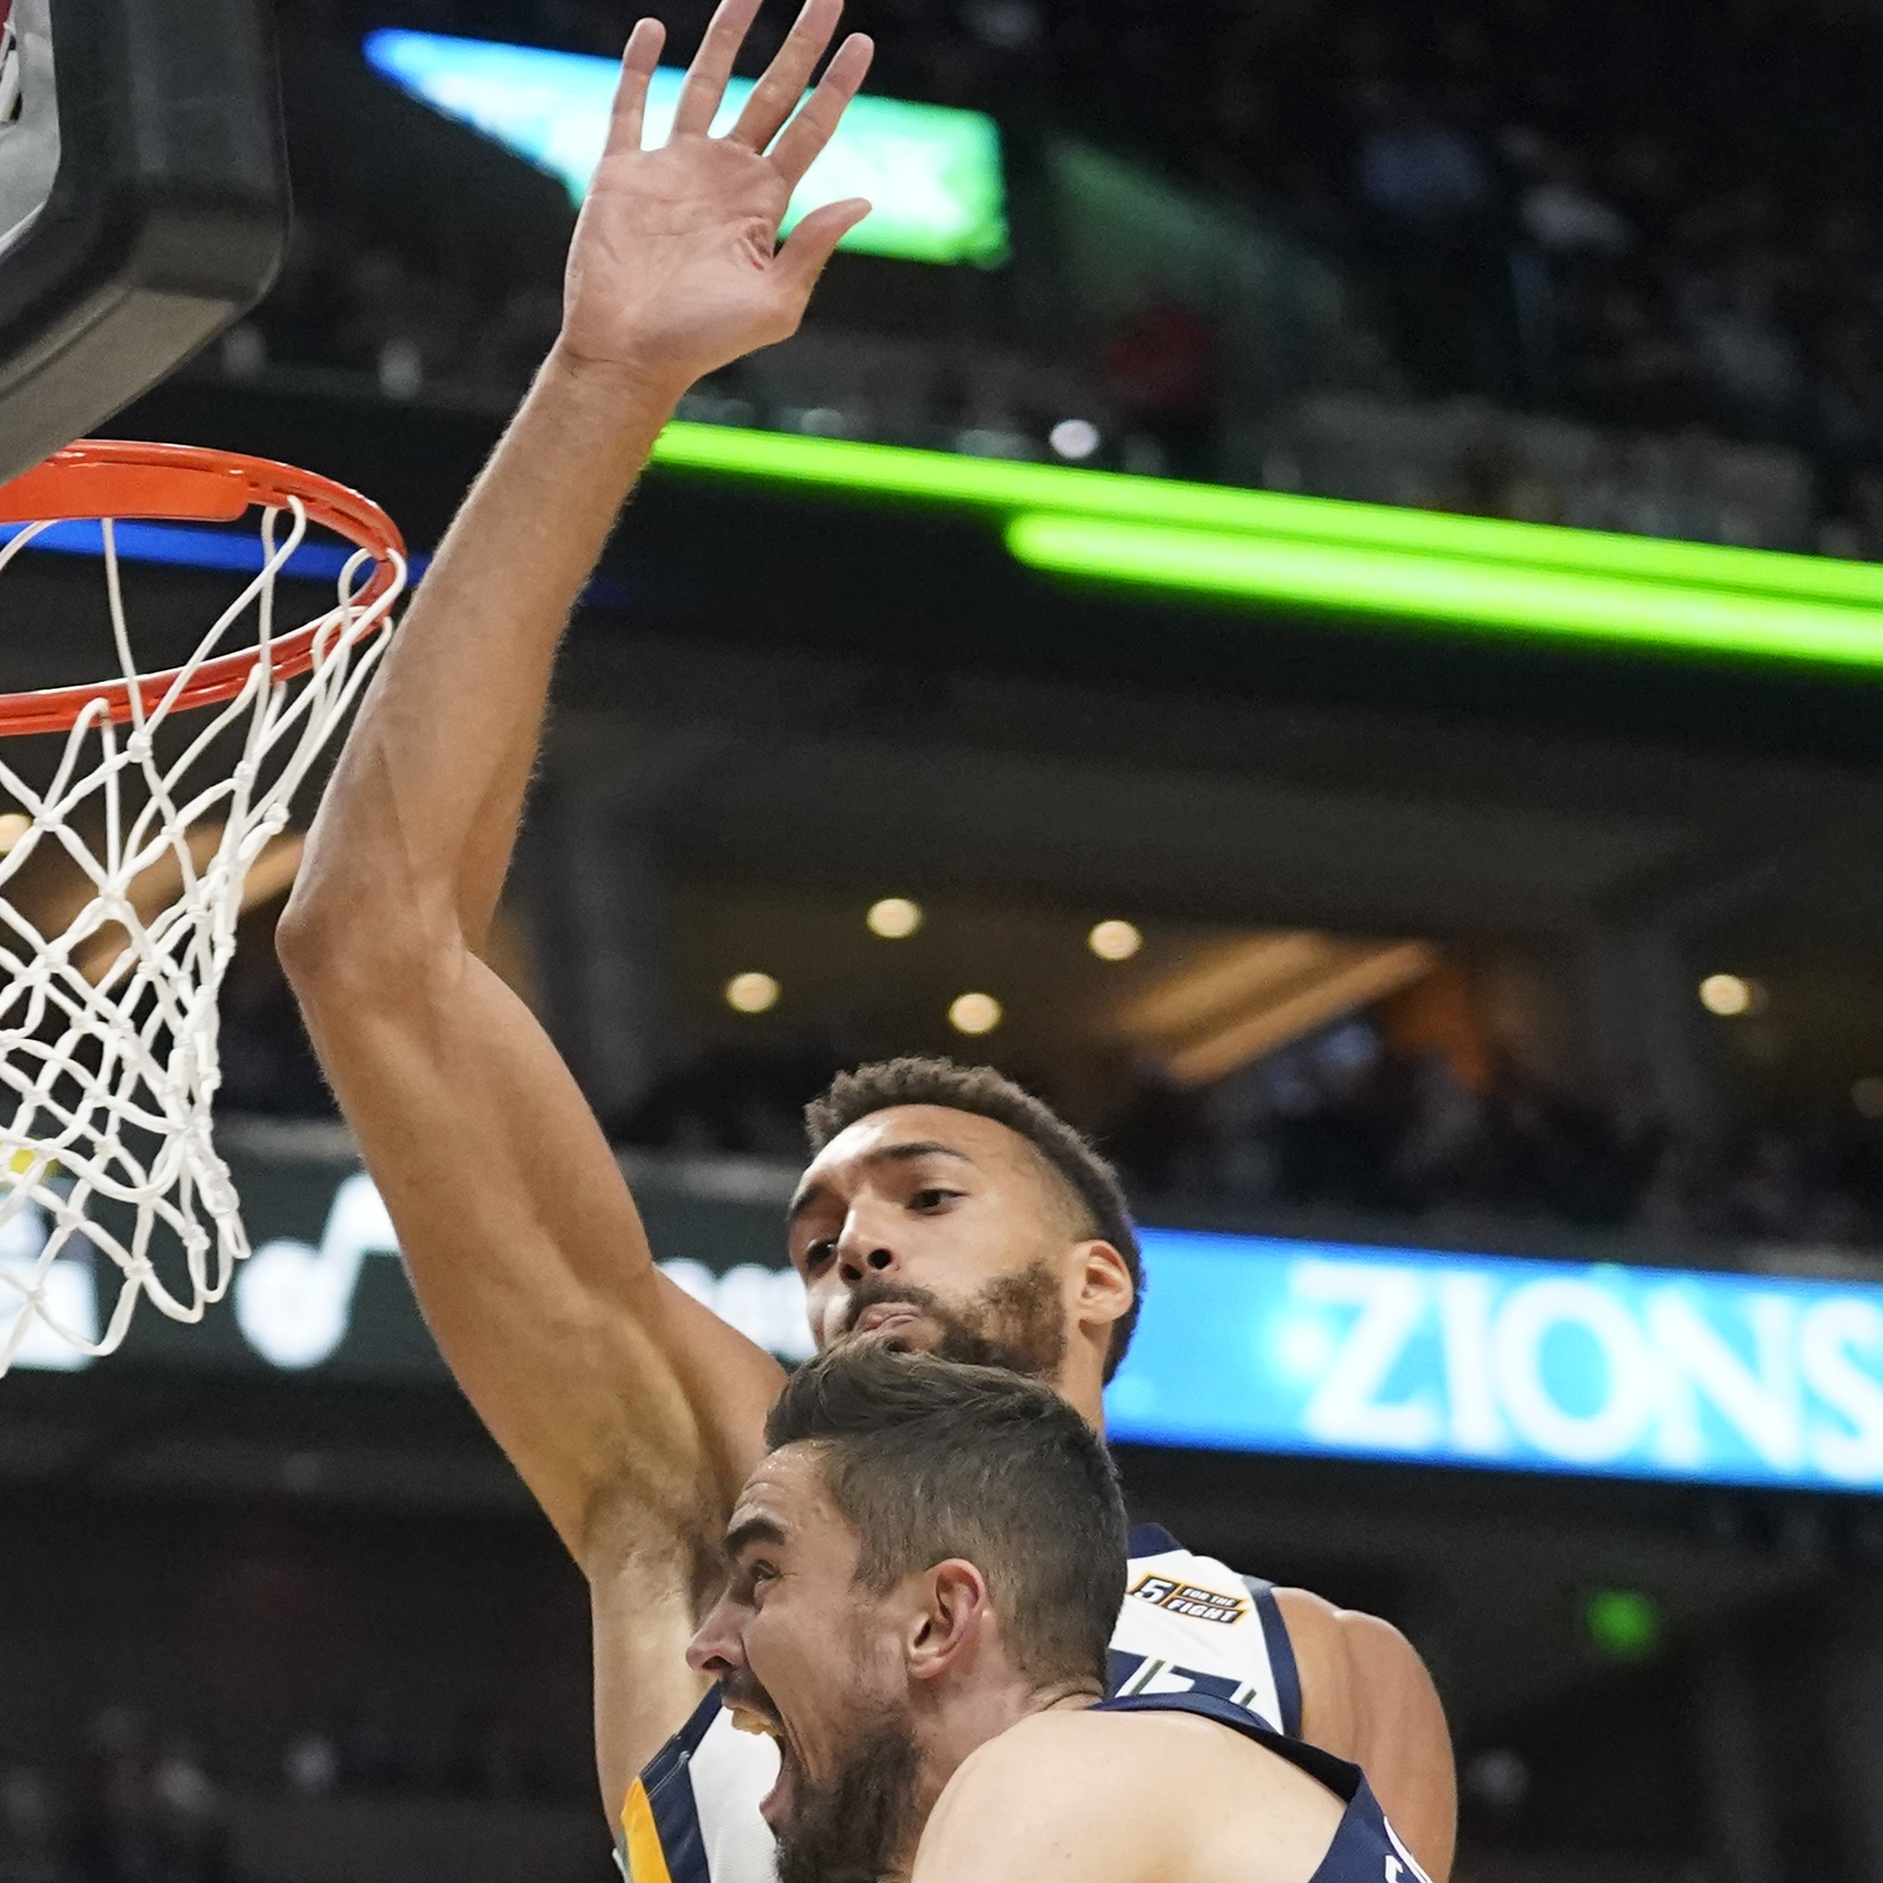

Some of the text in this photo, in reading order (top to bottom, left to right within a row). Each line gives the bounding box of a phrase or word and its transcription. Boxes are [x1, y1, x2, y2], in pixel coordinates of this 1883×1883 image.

[1133, 1578, 1237, 1607] 5 FOR THE
[1166, 1598, 1239, 1622] FIGHT
